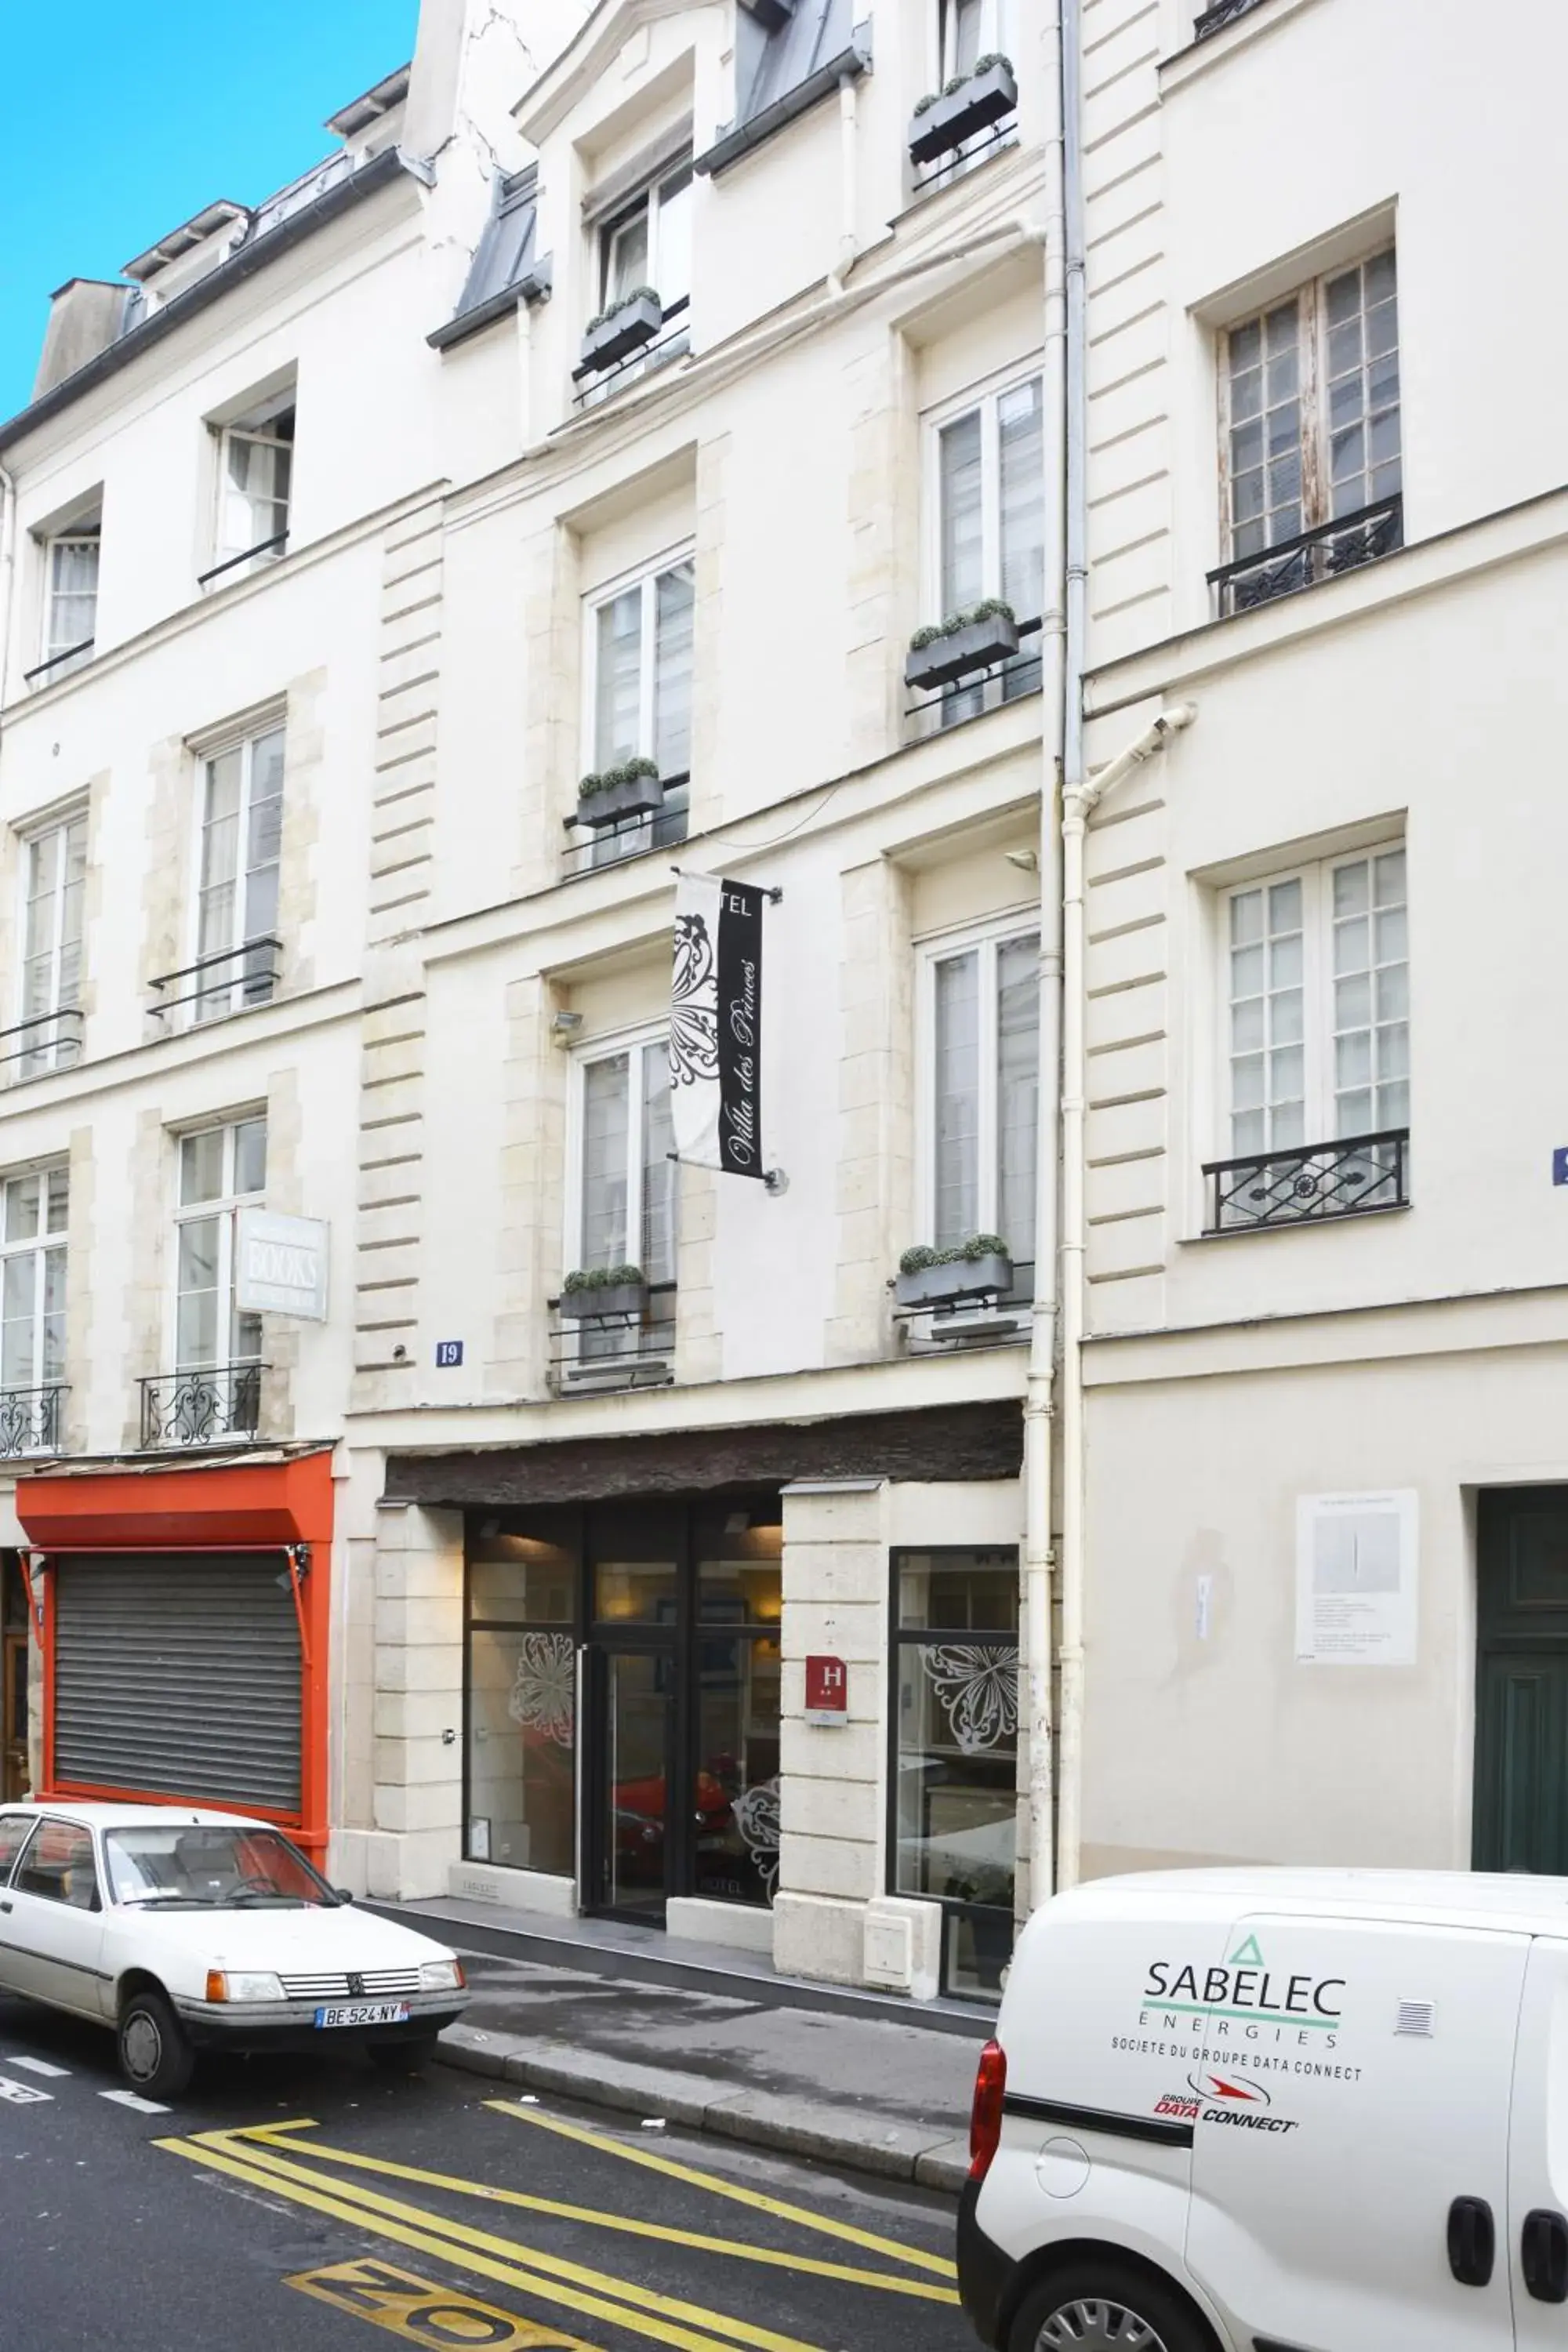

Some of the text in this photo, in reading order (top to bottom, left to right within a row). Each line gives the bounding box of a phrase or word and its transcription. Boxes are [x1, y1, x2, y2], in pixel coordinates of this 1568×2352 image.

[724, 958, 756, 1164] Villa des Princes
[440, 1344, 458, 1364] 19
[823, 1666, 841, 1686] H
[1144, 1962, 1346, 2016] SABELEC
[1138, 2011, 1338, 2049] ENERGIES
[1111, 2037, 1363, 2082] SOCIETE DU GROUPE DATA CONNECT
[1153, 2101, 1296, 2133] DATA CONNECT
[1161, 2094, 1204, 2106] GROUPE
